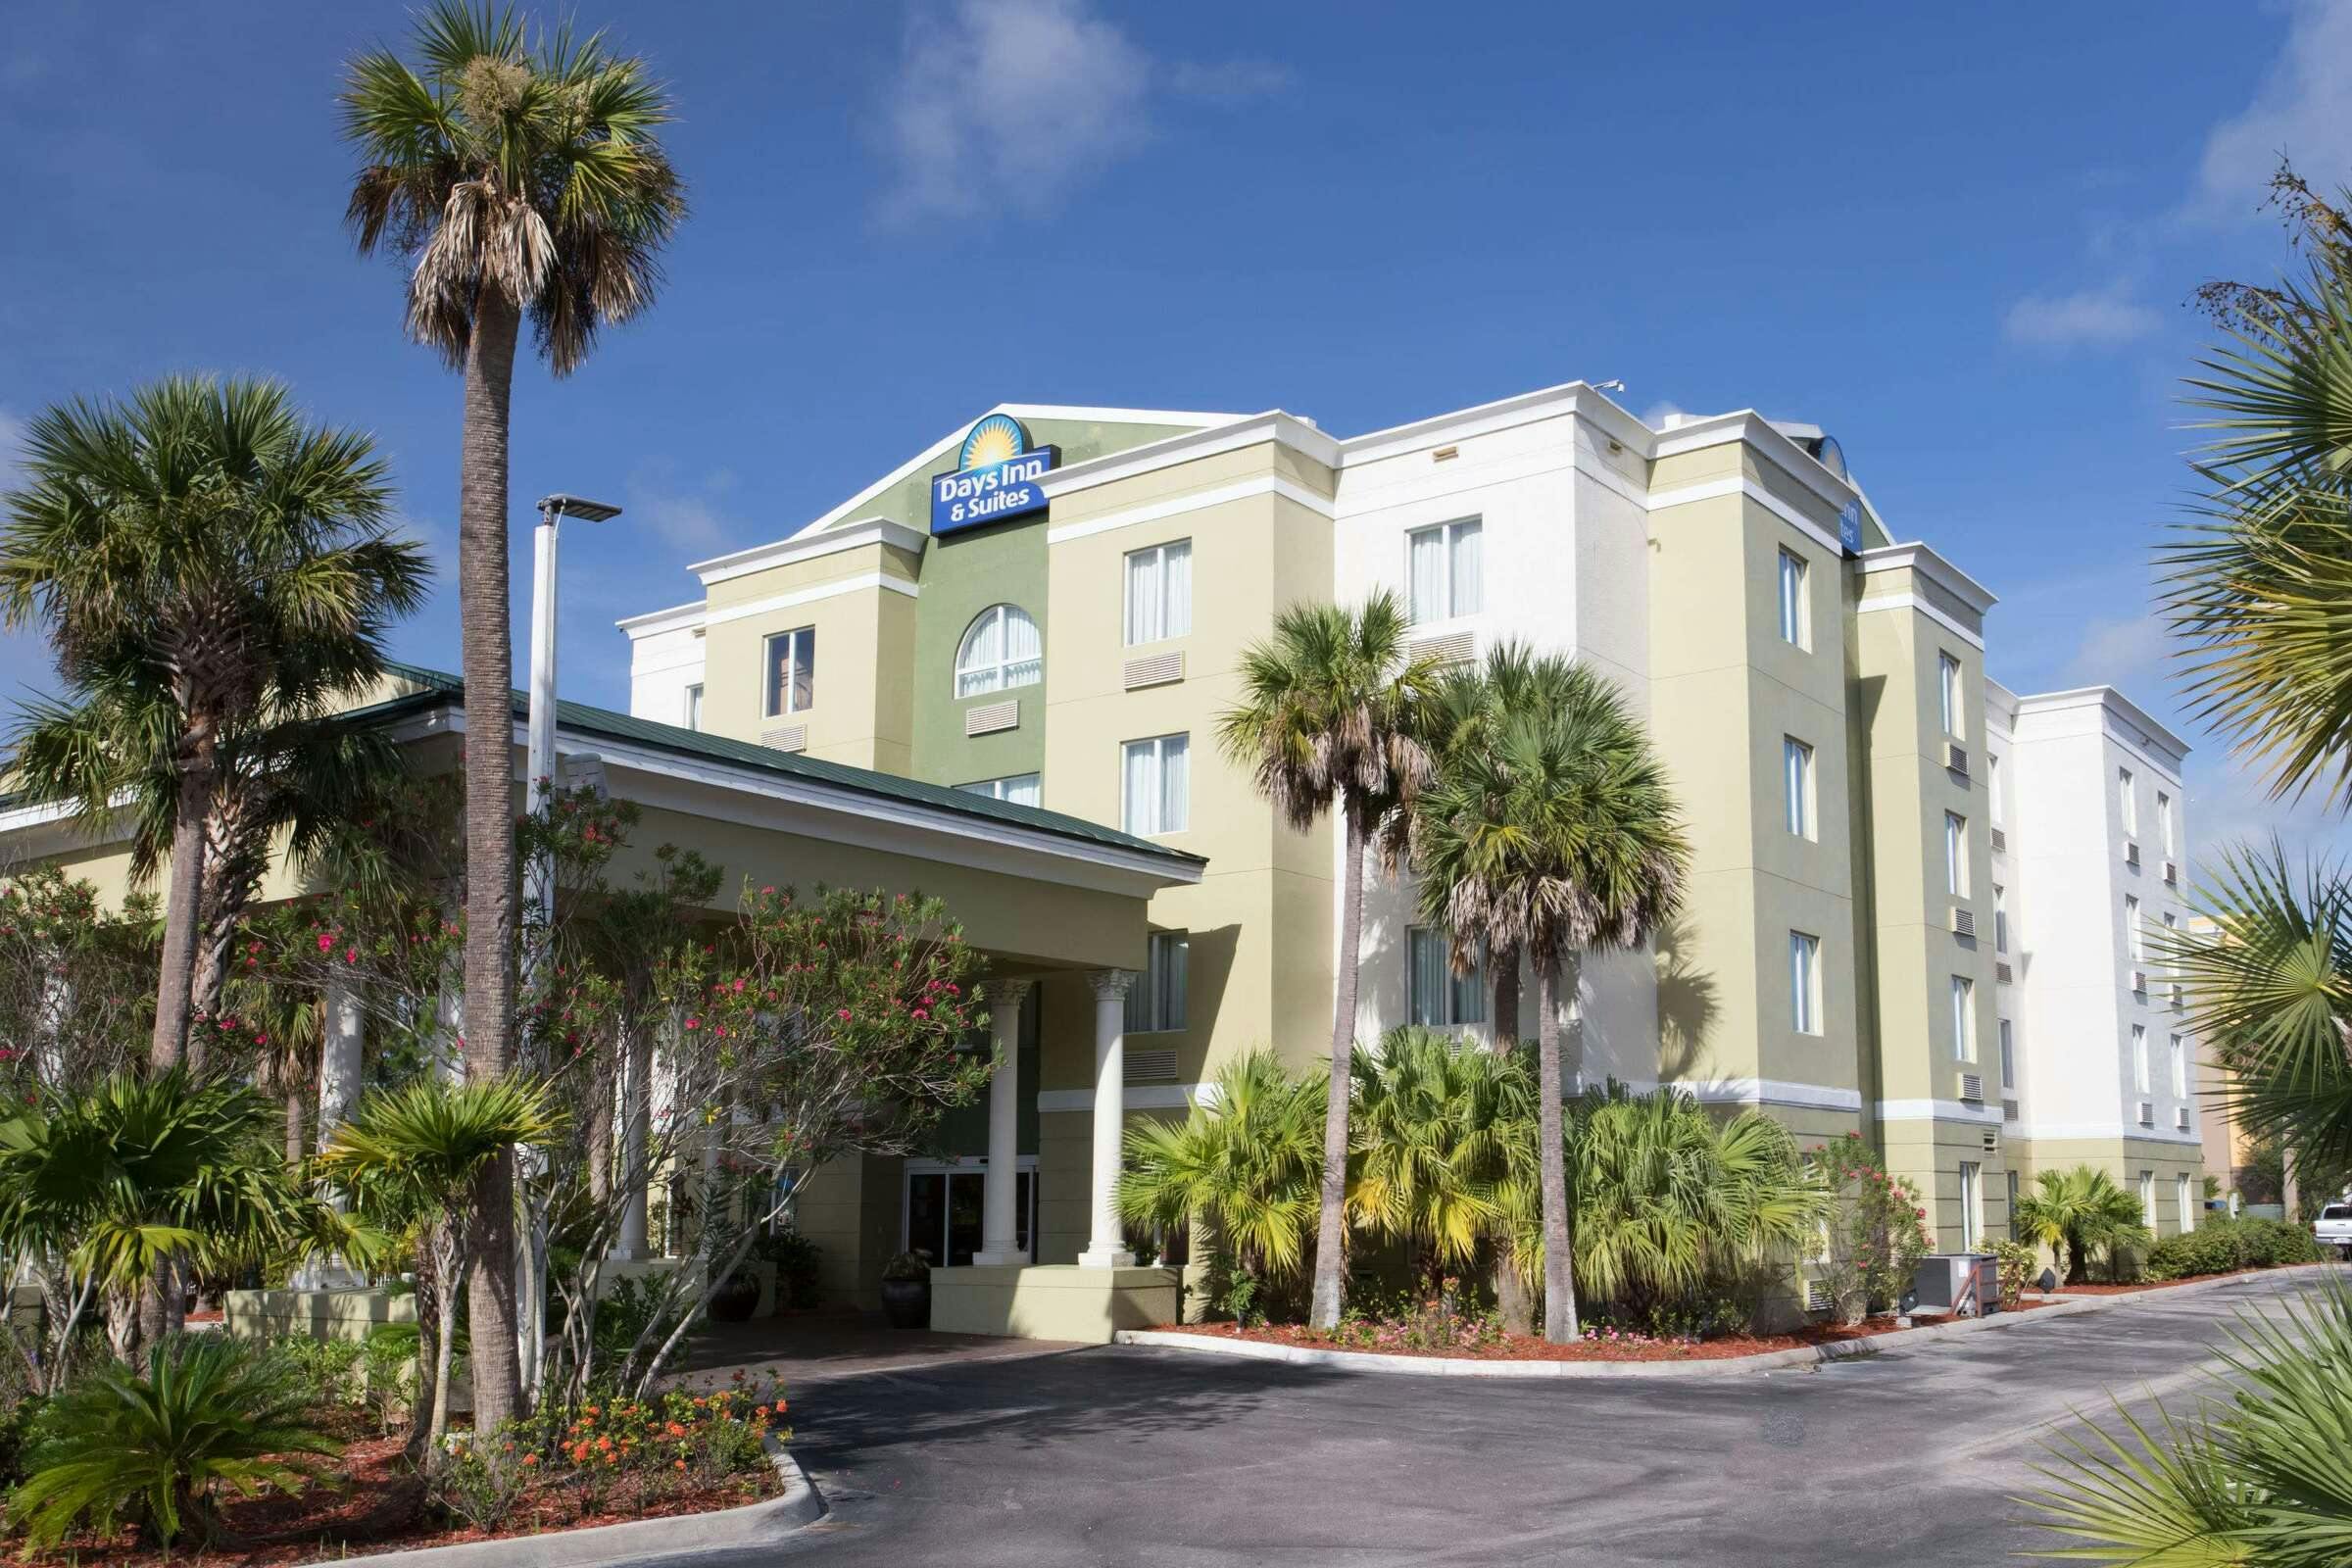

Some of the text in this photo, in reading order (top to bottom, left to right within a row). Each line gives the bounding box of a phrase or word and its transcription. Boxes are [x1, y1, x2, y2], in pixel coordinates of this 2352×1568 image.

[941, 459, 1042, 503] Days Inn
[951, 488, 1030, 522] & Suites
[1841, 503, 1858, 526] nn
[1840, 519, 1854, 543] tes
